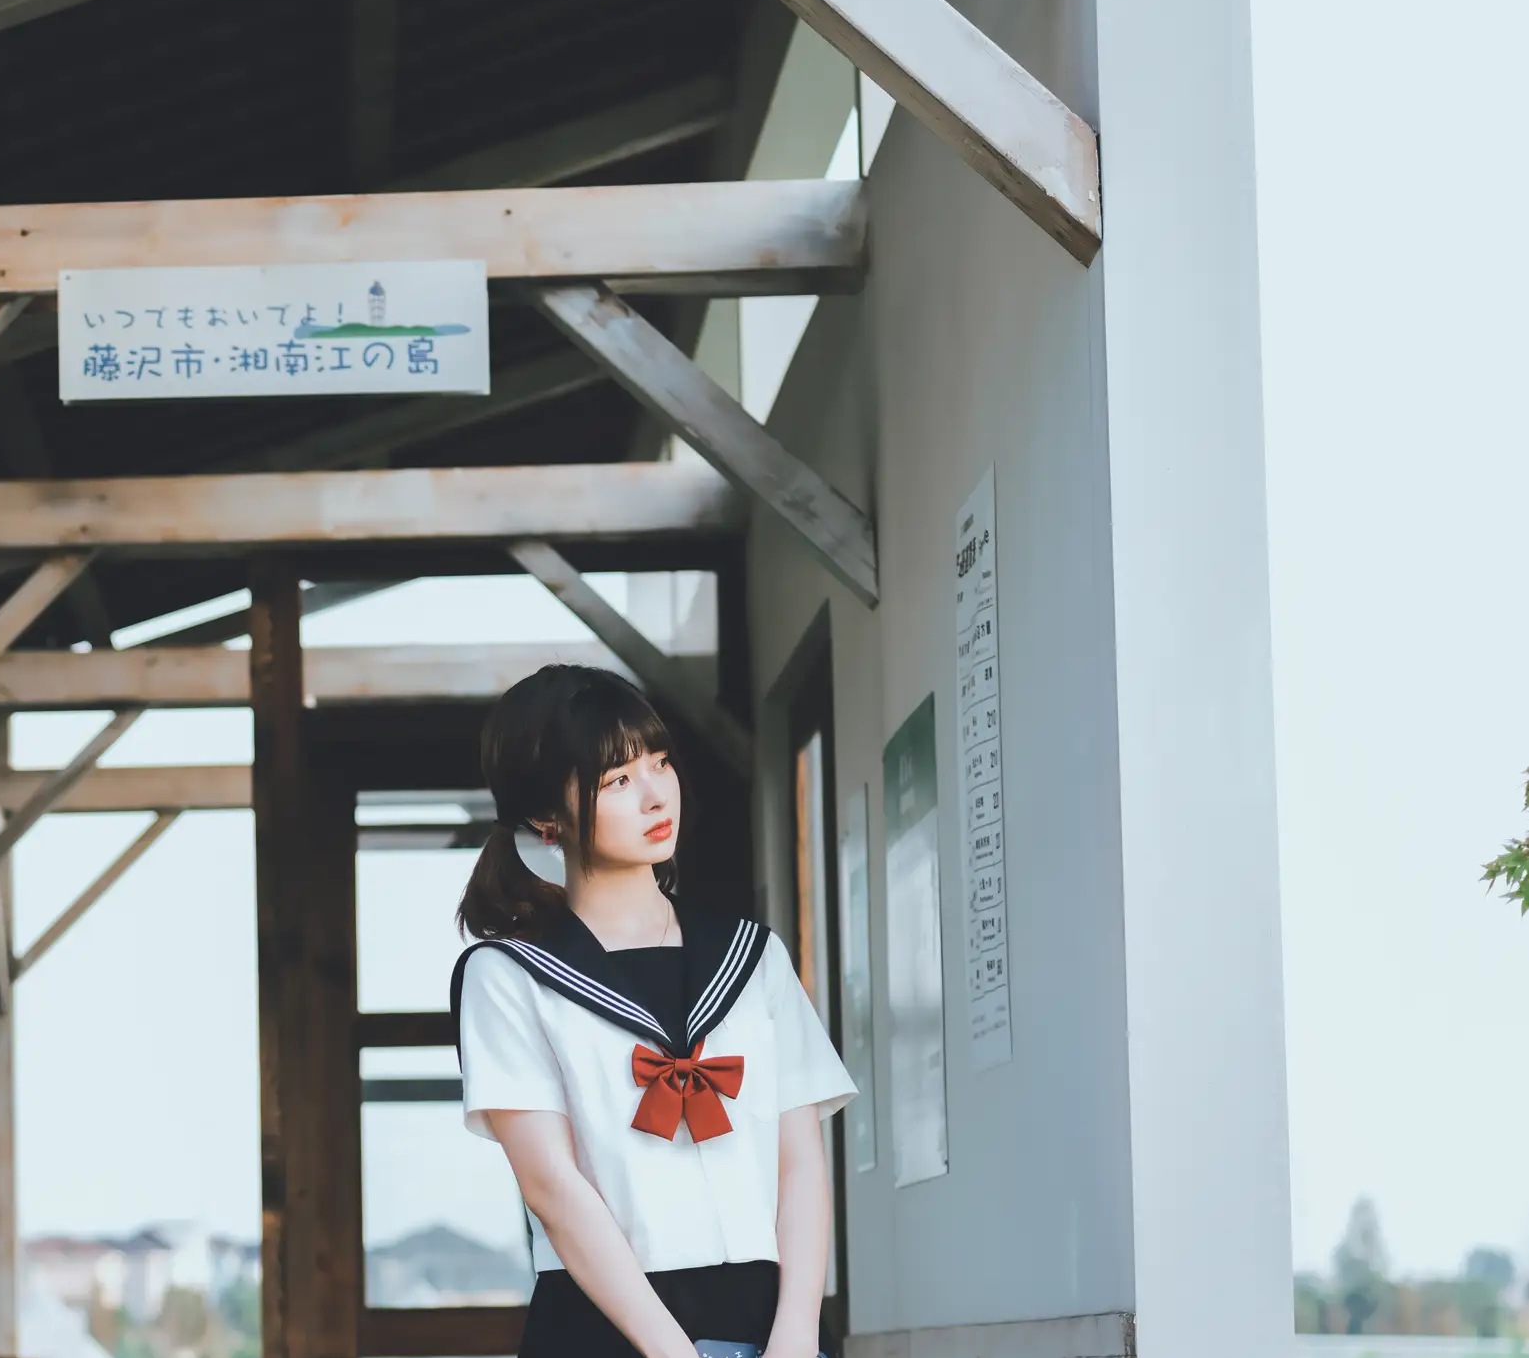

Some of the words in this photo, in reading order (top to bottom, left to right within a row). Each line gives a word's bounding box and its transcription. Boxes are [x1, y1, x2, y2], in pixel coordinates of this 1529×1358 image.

[83, 337, 439, 381] 藤沢市・湘南江の島
